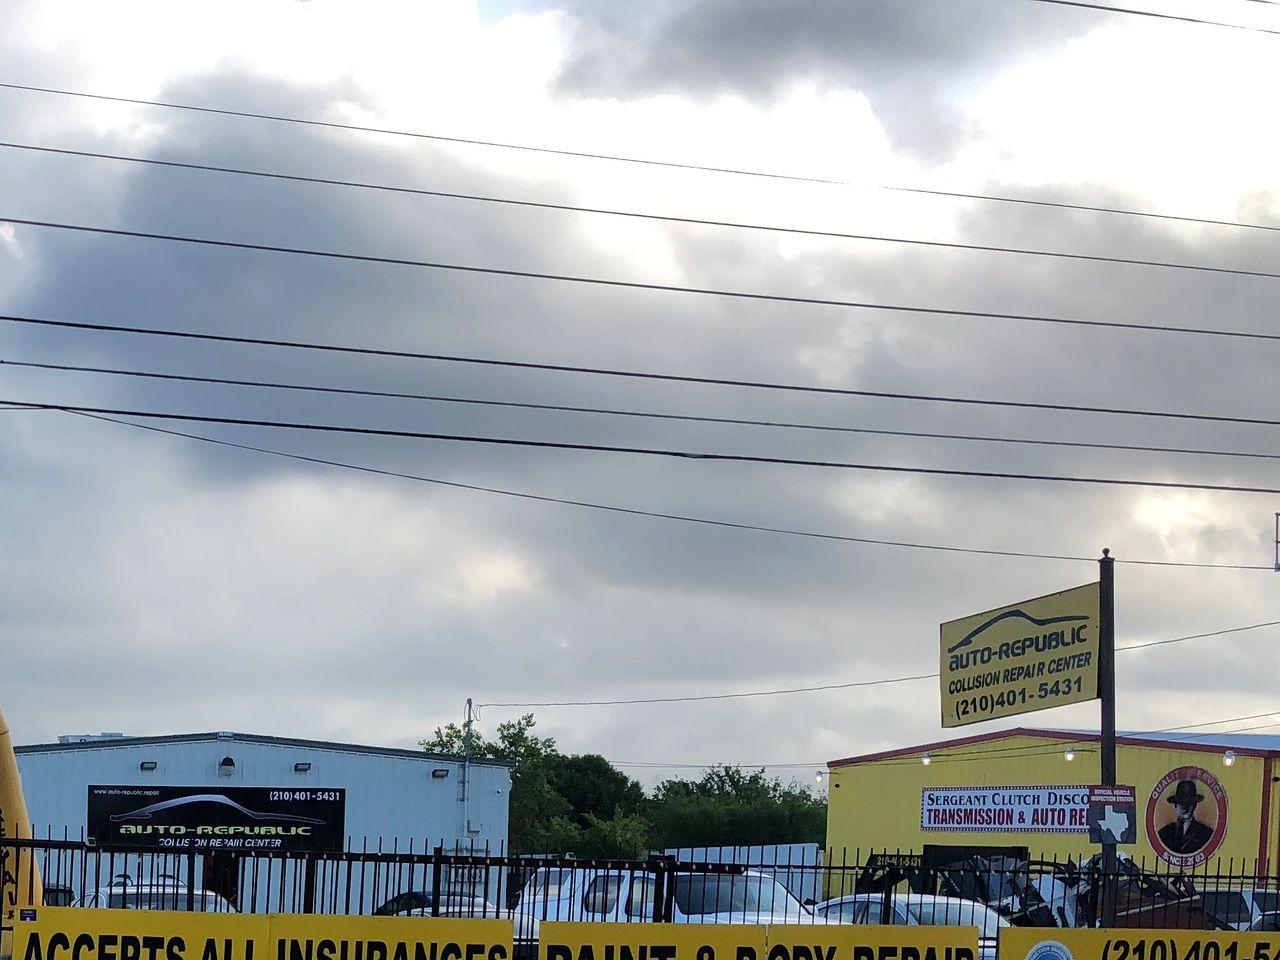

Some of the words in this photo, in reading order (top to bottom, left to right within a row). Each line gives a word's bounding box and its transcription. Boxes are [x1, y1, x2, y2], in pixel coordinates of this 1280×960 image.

[949, 624, 1087, 672] AUTO-REPUBLIC
[949, 670, 1000, 695] COLLISION
[1002, 661, 1045, 684] REPAIR
[1047, 651, 1092, 675] CENTER
[1151, 769, 1181, 800] QUALIT
[1193, 769, 1223, 800] ERVICE
[927, 792, 988, 806] SERGEANT
[996, 792, 1040, 806] CLUTCH
[926, 808, 1013, 826] TRANSMISSION
[1018, 810, 1026, 824] &
[1031, 807, 1066, 826] AUTO
[1069, 807, 1089, 826] RE
[120, 825, 312, 835] AUTO-REPUBLIC
[209, 838, 243, 847] REPAIR
[1162, 851, 1186, 867] SNC
